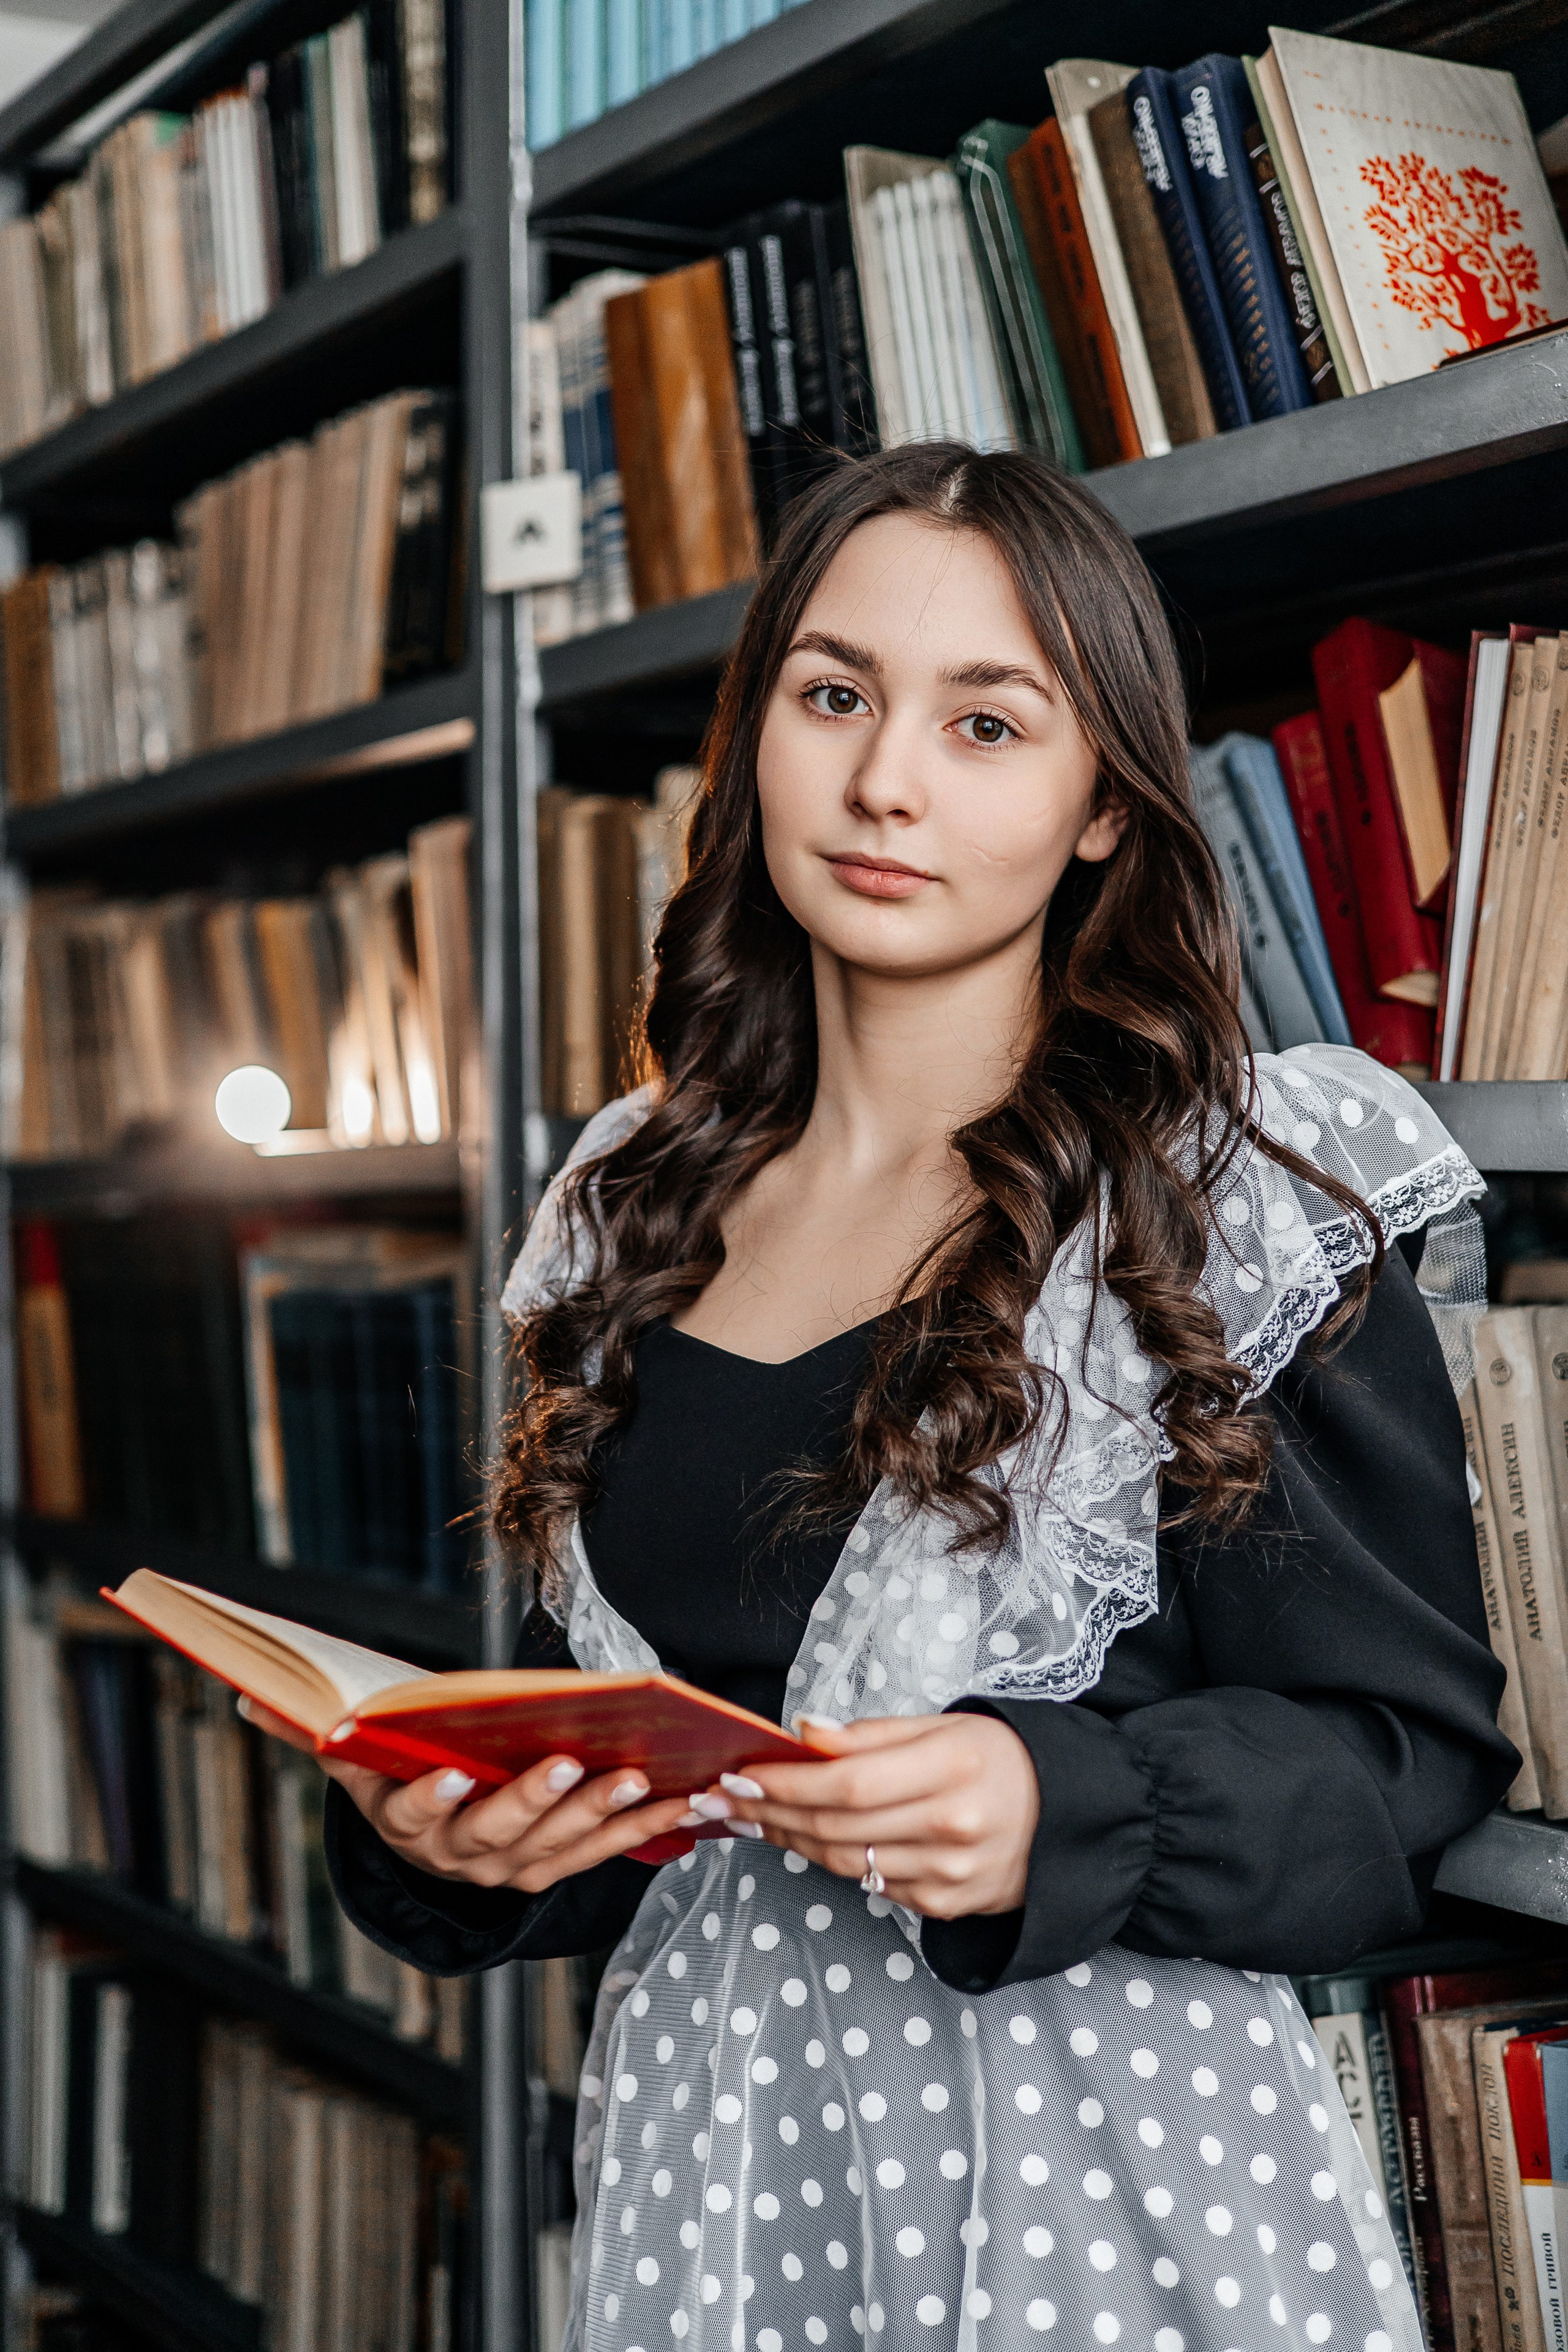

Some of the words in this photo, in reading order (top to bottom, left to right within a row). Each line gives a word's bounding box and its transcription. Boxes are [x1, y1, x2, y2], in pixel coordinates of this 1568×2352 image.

[1551, 791, 1564, 839] ФЕДОР
[1501, 1422, 1526, 1519] АЛЕКСИН
[1513, 1530, 1543, 1642] АНАТОЛИЙ
[1409, 2116, 1428, 2201] Рассказы
[1541, 2233, 1558, 2290] ГРИВОЙ
